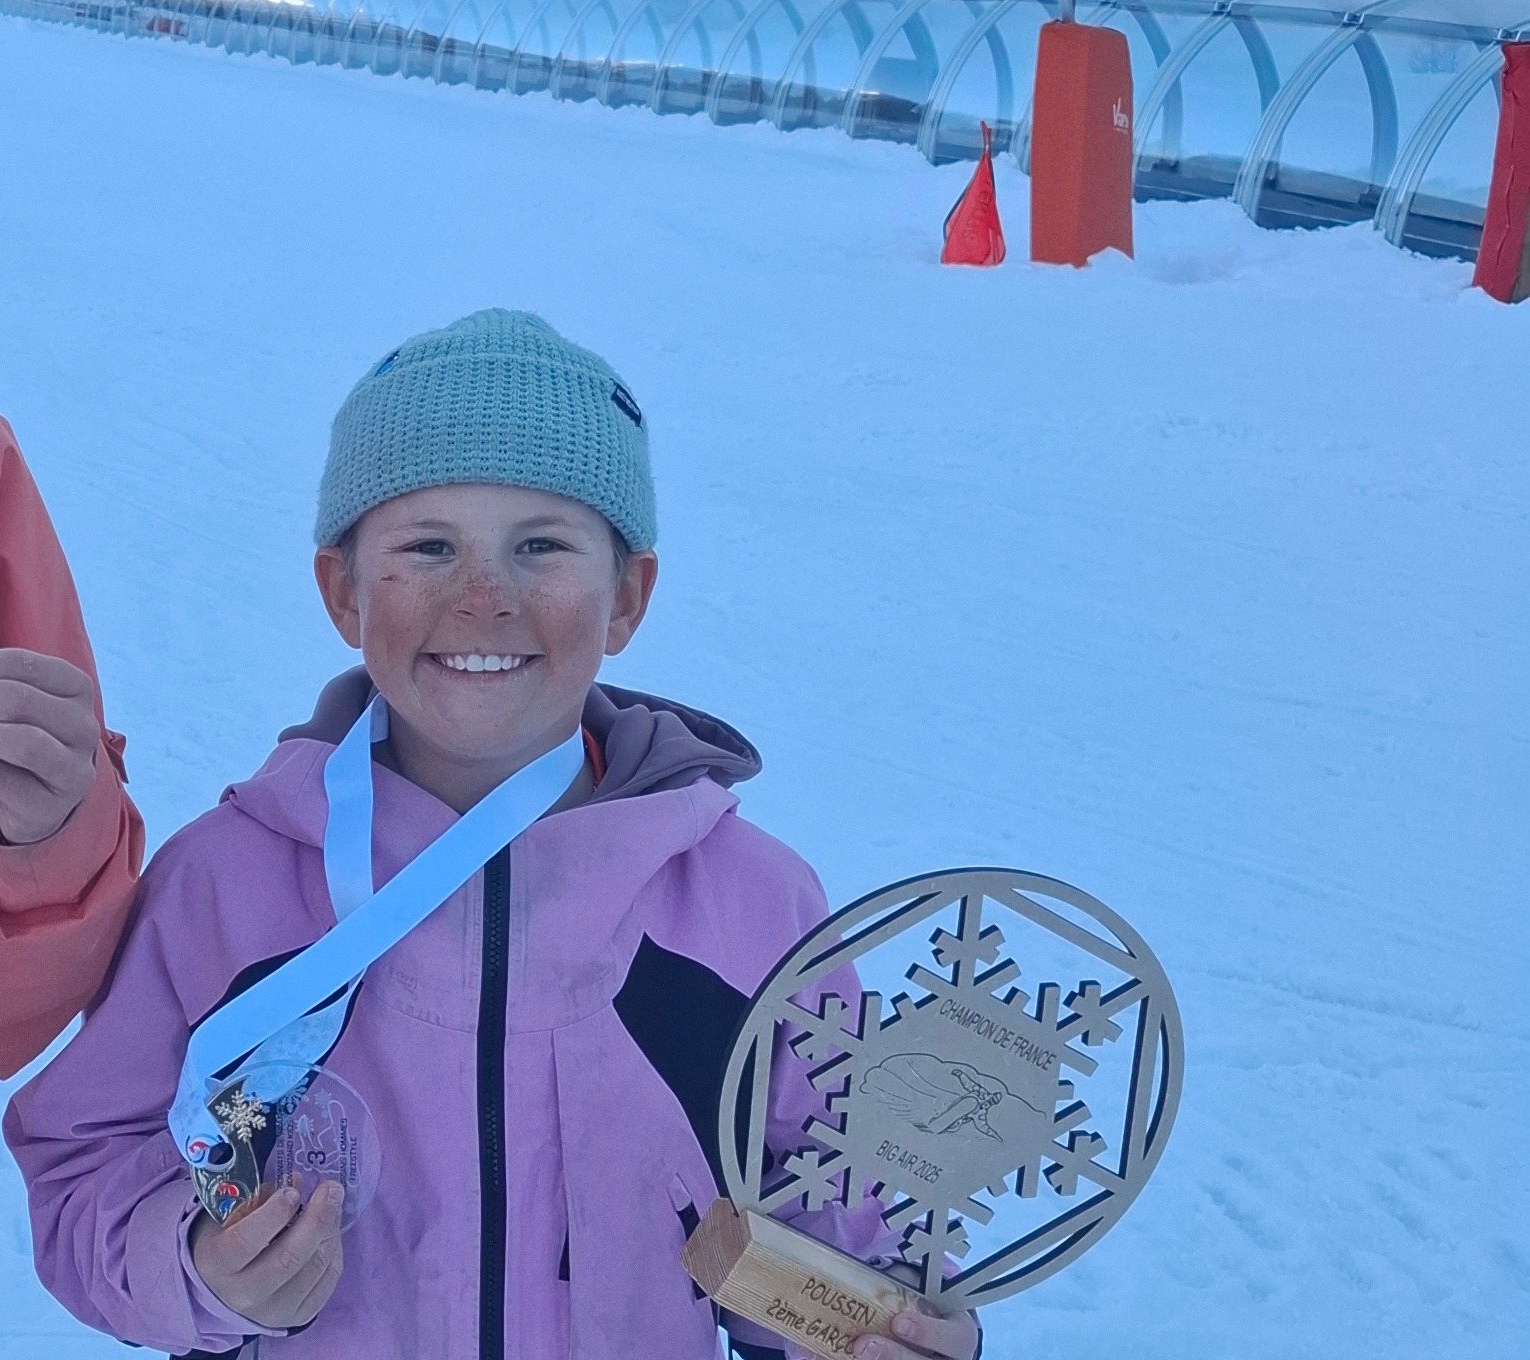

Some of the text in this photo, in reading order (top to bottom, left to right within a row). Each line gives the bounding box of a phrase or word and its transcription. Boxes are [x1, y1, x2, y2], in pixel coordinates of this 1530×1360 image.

[939, 998, 1057, 1071] CHAMPION DE FRANCE
[286, 1141, 294, 1187] NOWBOARD
[307, 1150, 327, 1165] 3
[876, 1140, 943, 1183] BIG AIR 2025
[801, 1278, 877, 1327] POUSSIN
[766, 1298, 856, 1358] 2ème GARÇO
